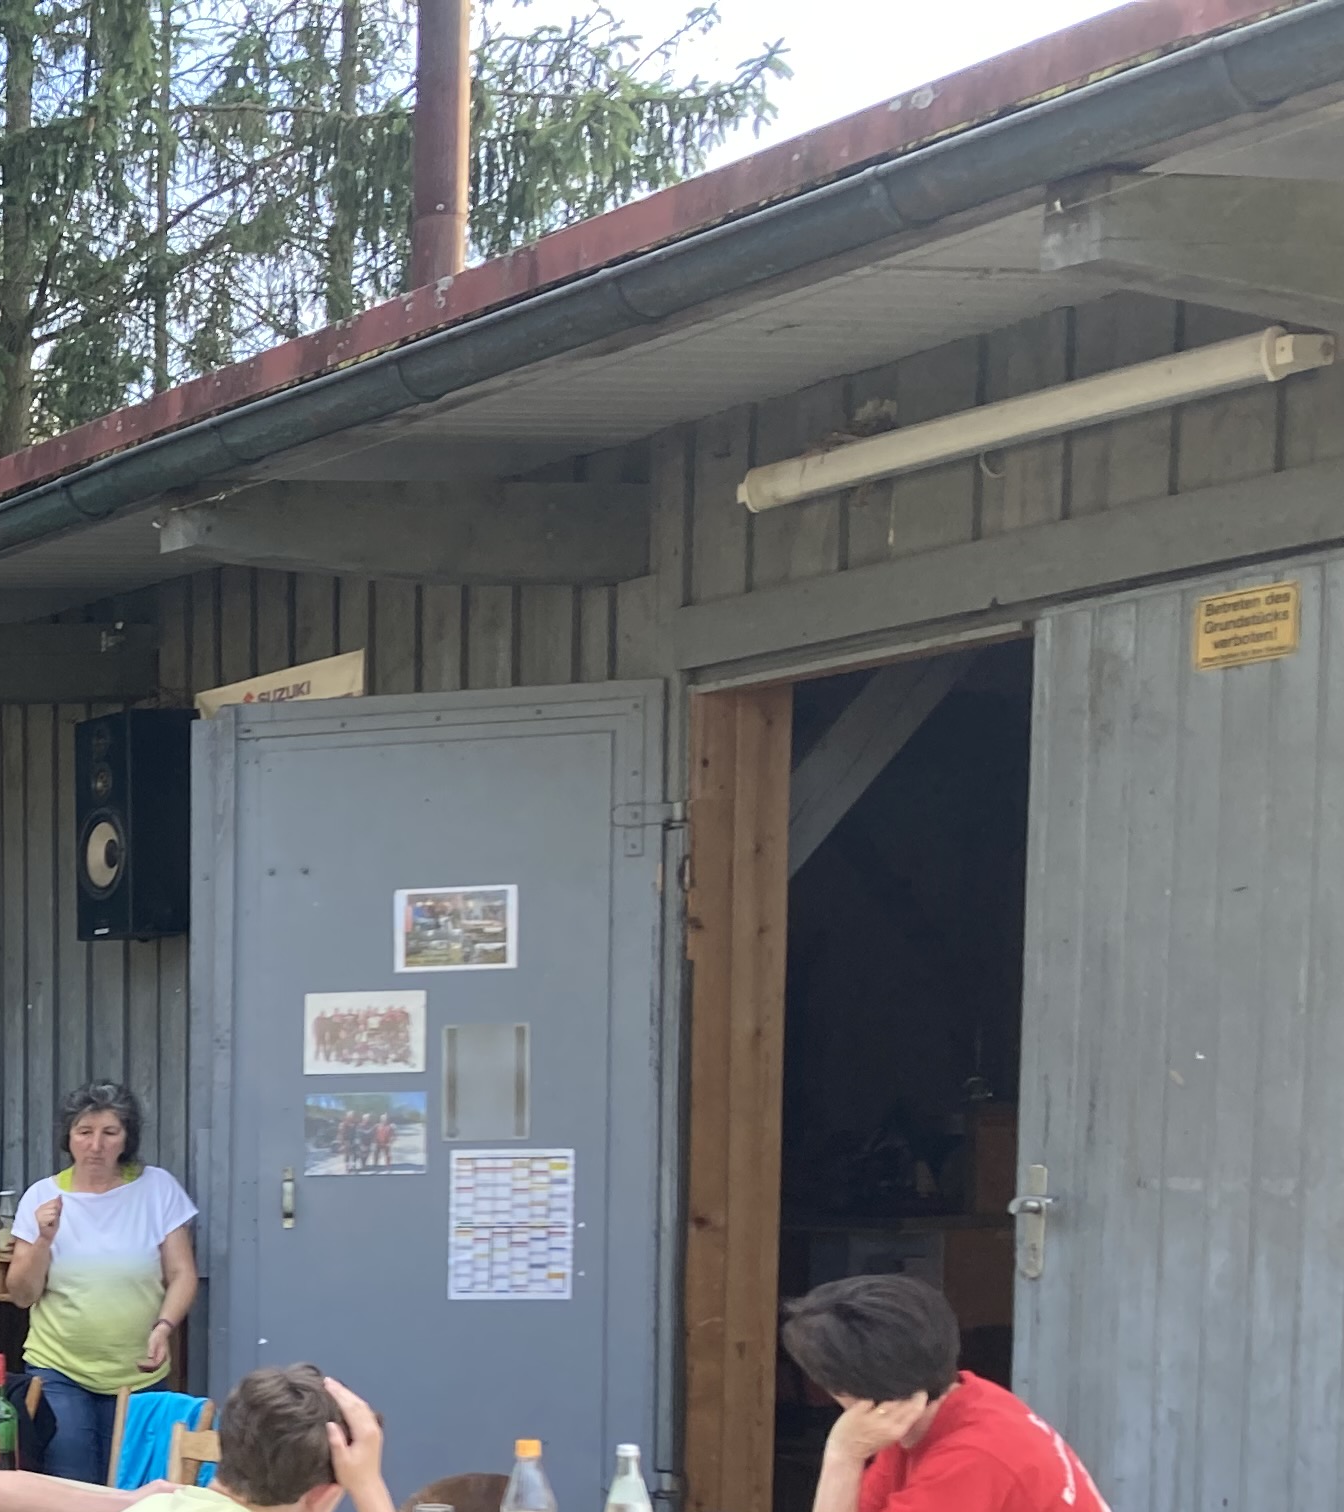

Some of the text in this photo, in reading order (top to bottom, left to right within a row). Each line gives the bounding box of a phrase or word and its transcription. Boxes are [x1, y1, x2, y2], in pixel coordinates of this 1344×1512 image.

[1204, 591, 1291, 617] Betreten des
[1204, 609, 1289, 634] Grundstücks
[257, 680, 311, 702] SUZUKI
